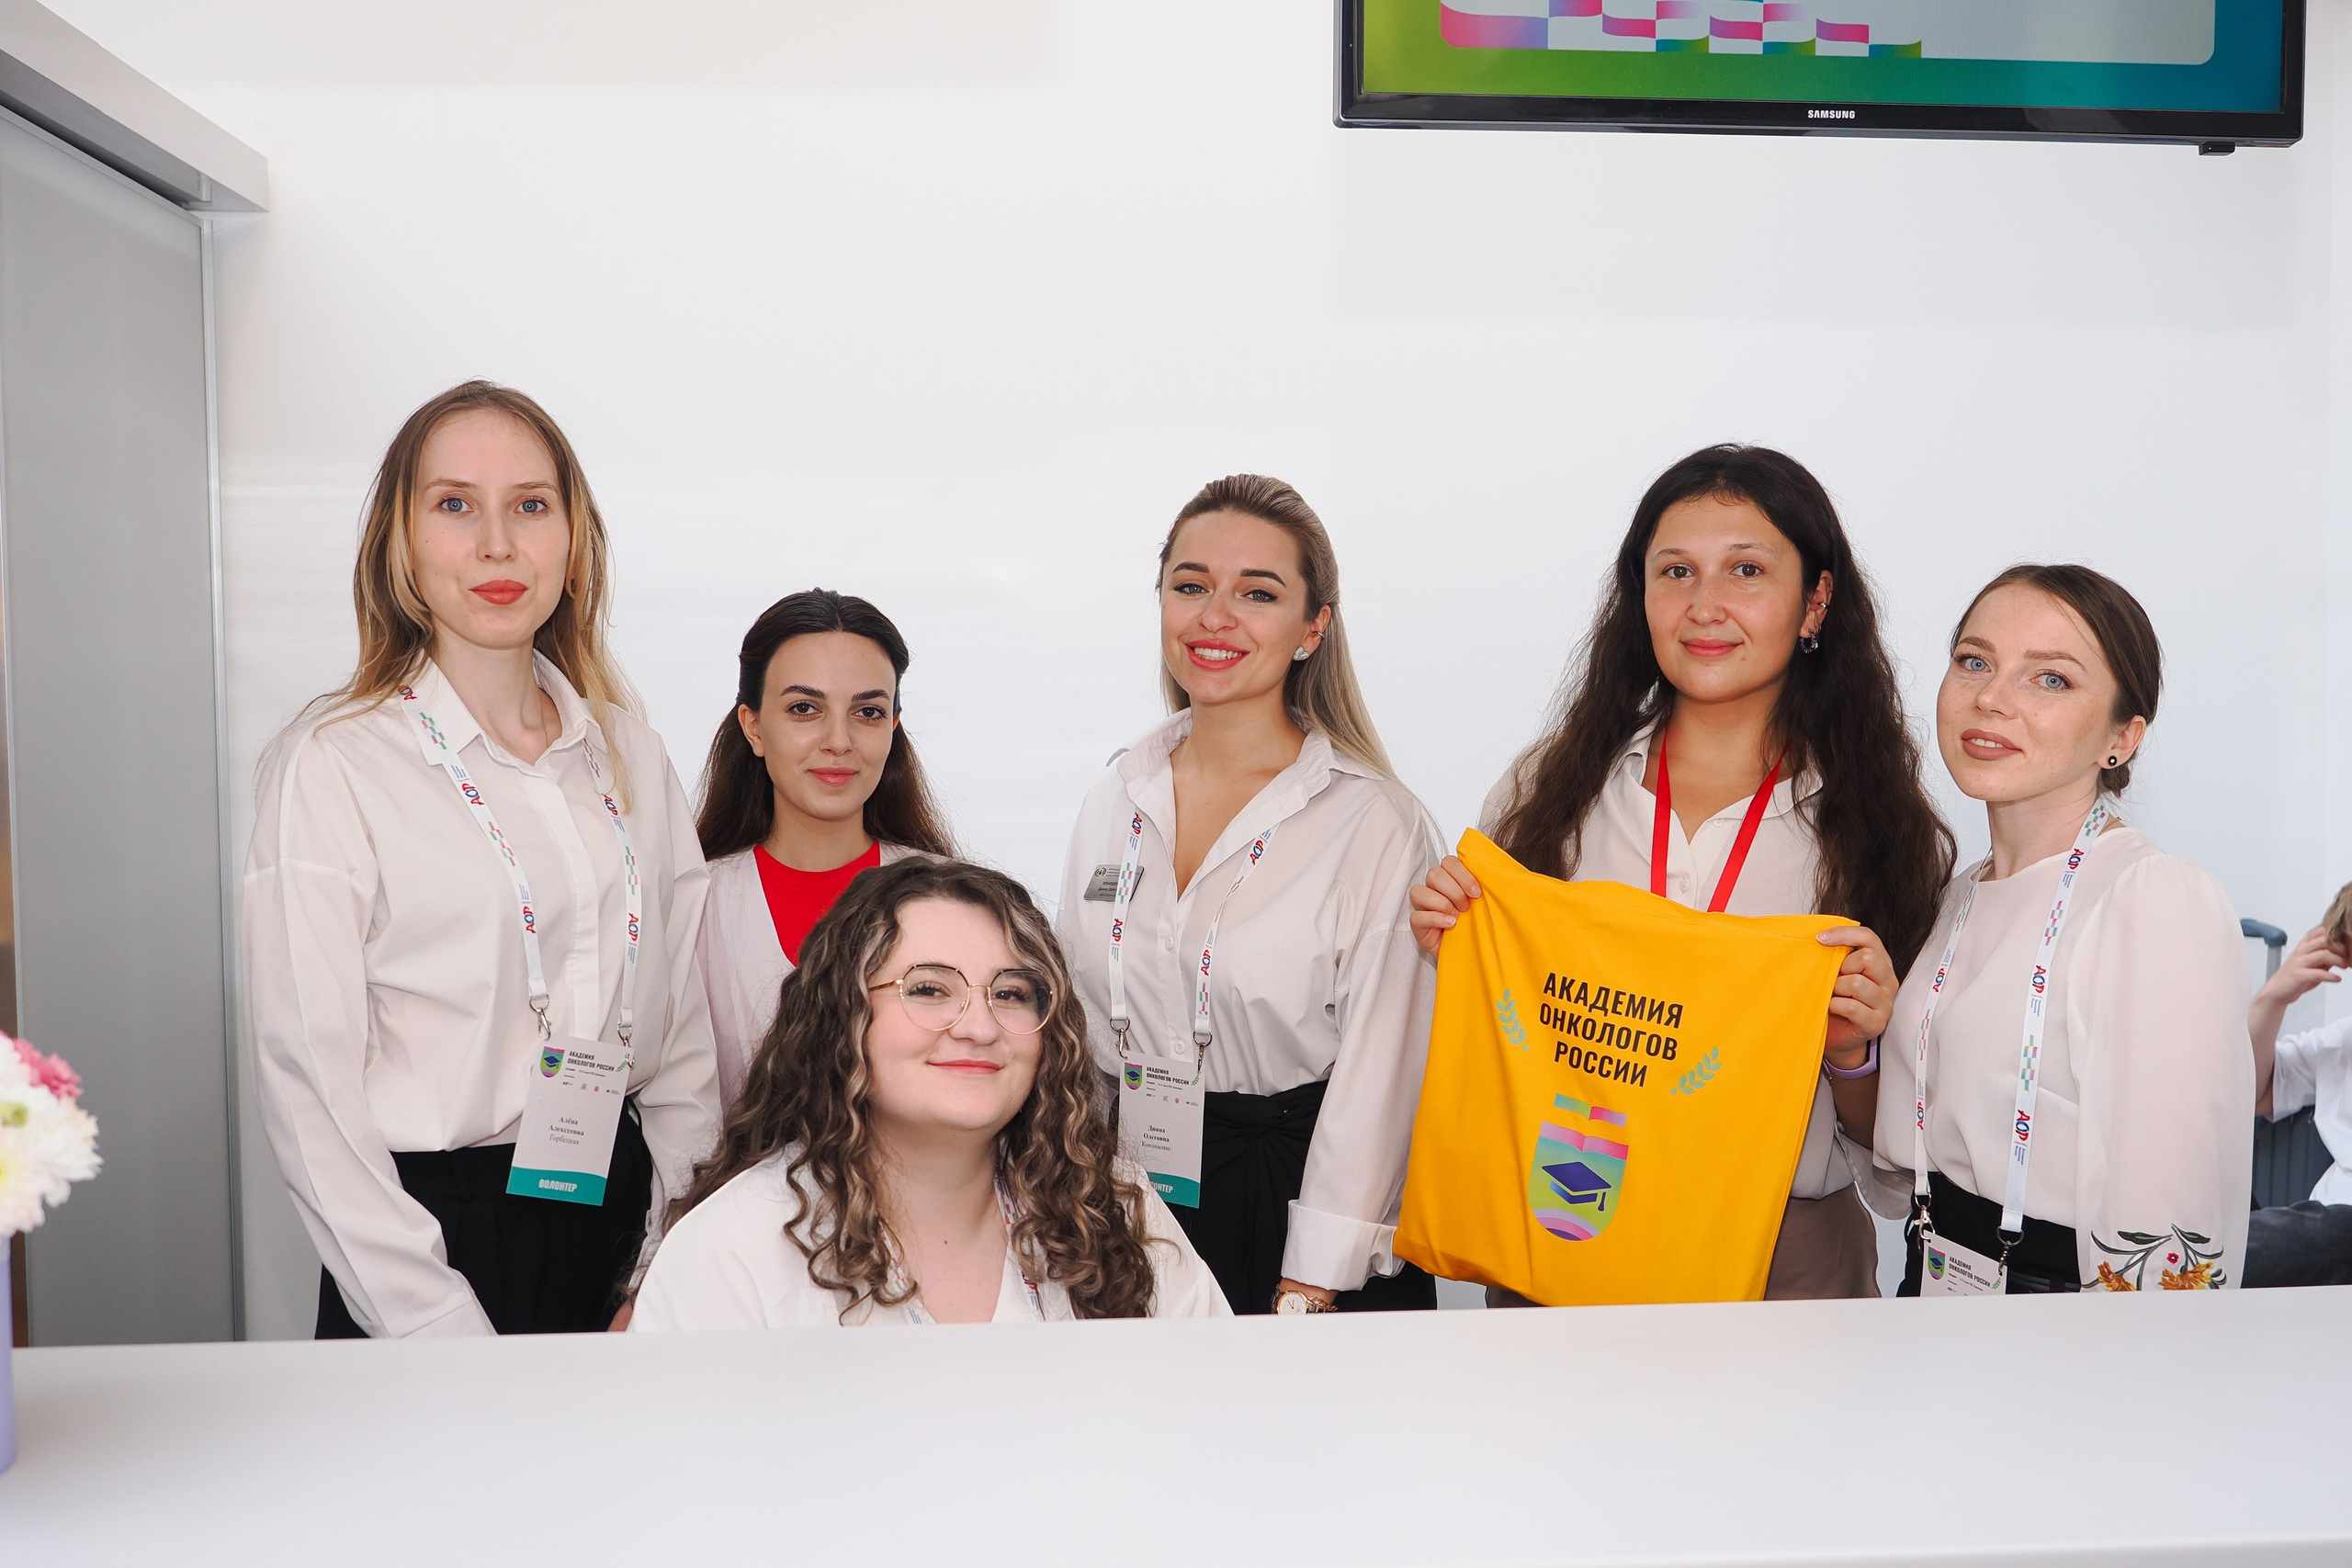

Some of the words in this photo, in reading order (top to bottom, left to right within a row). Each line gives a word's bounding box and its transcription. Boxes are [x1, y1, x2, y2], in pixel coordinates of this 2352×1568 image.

[1807, 109, 1856, 119] SAMSUNG
[1543, 972, 1684, 1029] АКАДЕМИЯ
[1539, 1002, 1679, 1061] ОНКОЛОГОВ
[569, 1051, 595, 1060] АКАДЕМИЯ
[567, 1058, 595, 1068] ОНКОЛОГОВ
[595, 1063, 615, 1071] РОССИИ
[1146, 1066, 1170, 1075] АКАДЕМИЯ
[1554, 1040, 1648, 1088] РОССИИ
[1146, 1073, 1171, 1082] ОНКОЛОГОВ
[538, 1179, 578, 1193] ВОЛОНТЕР
[1149, 1181, 1174, 1193] ОНТЕР
[1949, 1256, 1972, 1270] АКАДЕМИЯ
[1948, 1263, 1973, 1280] ОНКОЛОГОВ
[1973, 1275, 1991, 1288] РОССИИ
